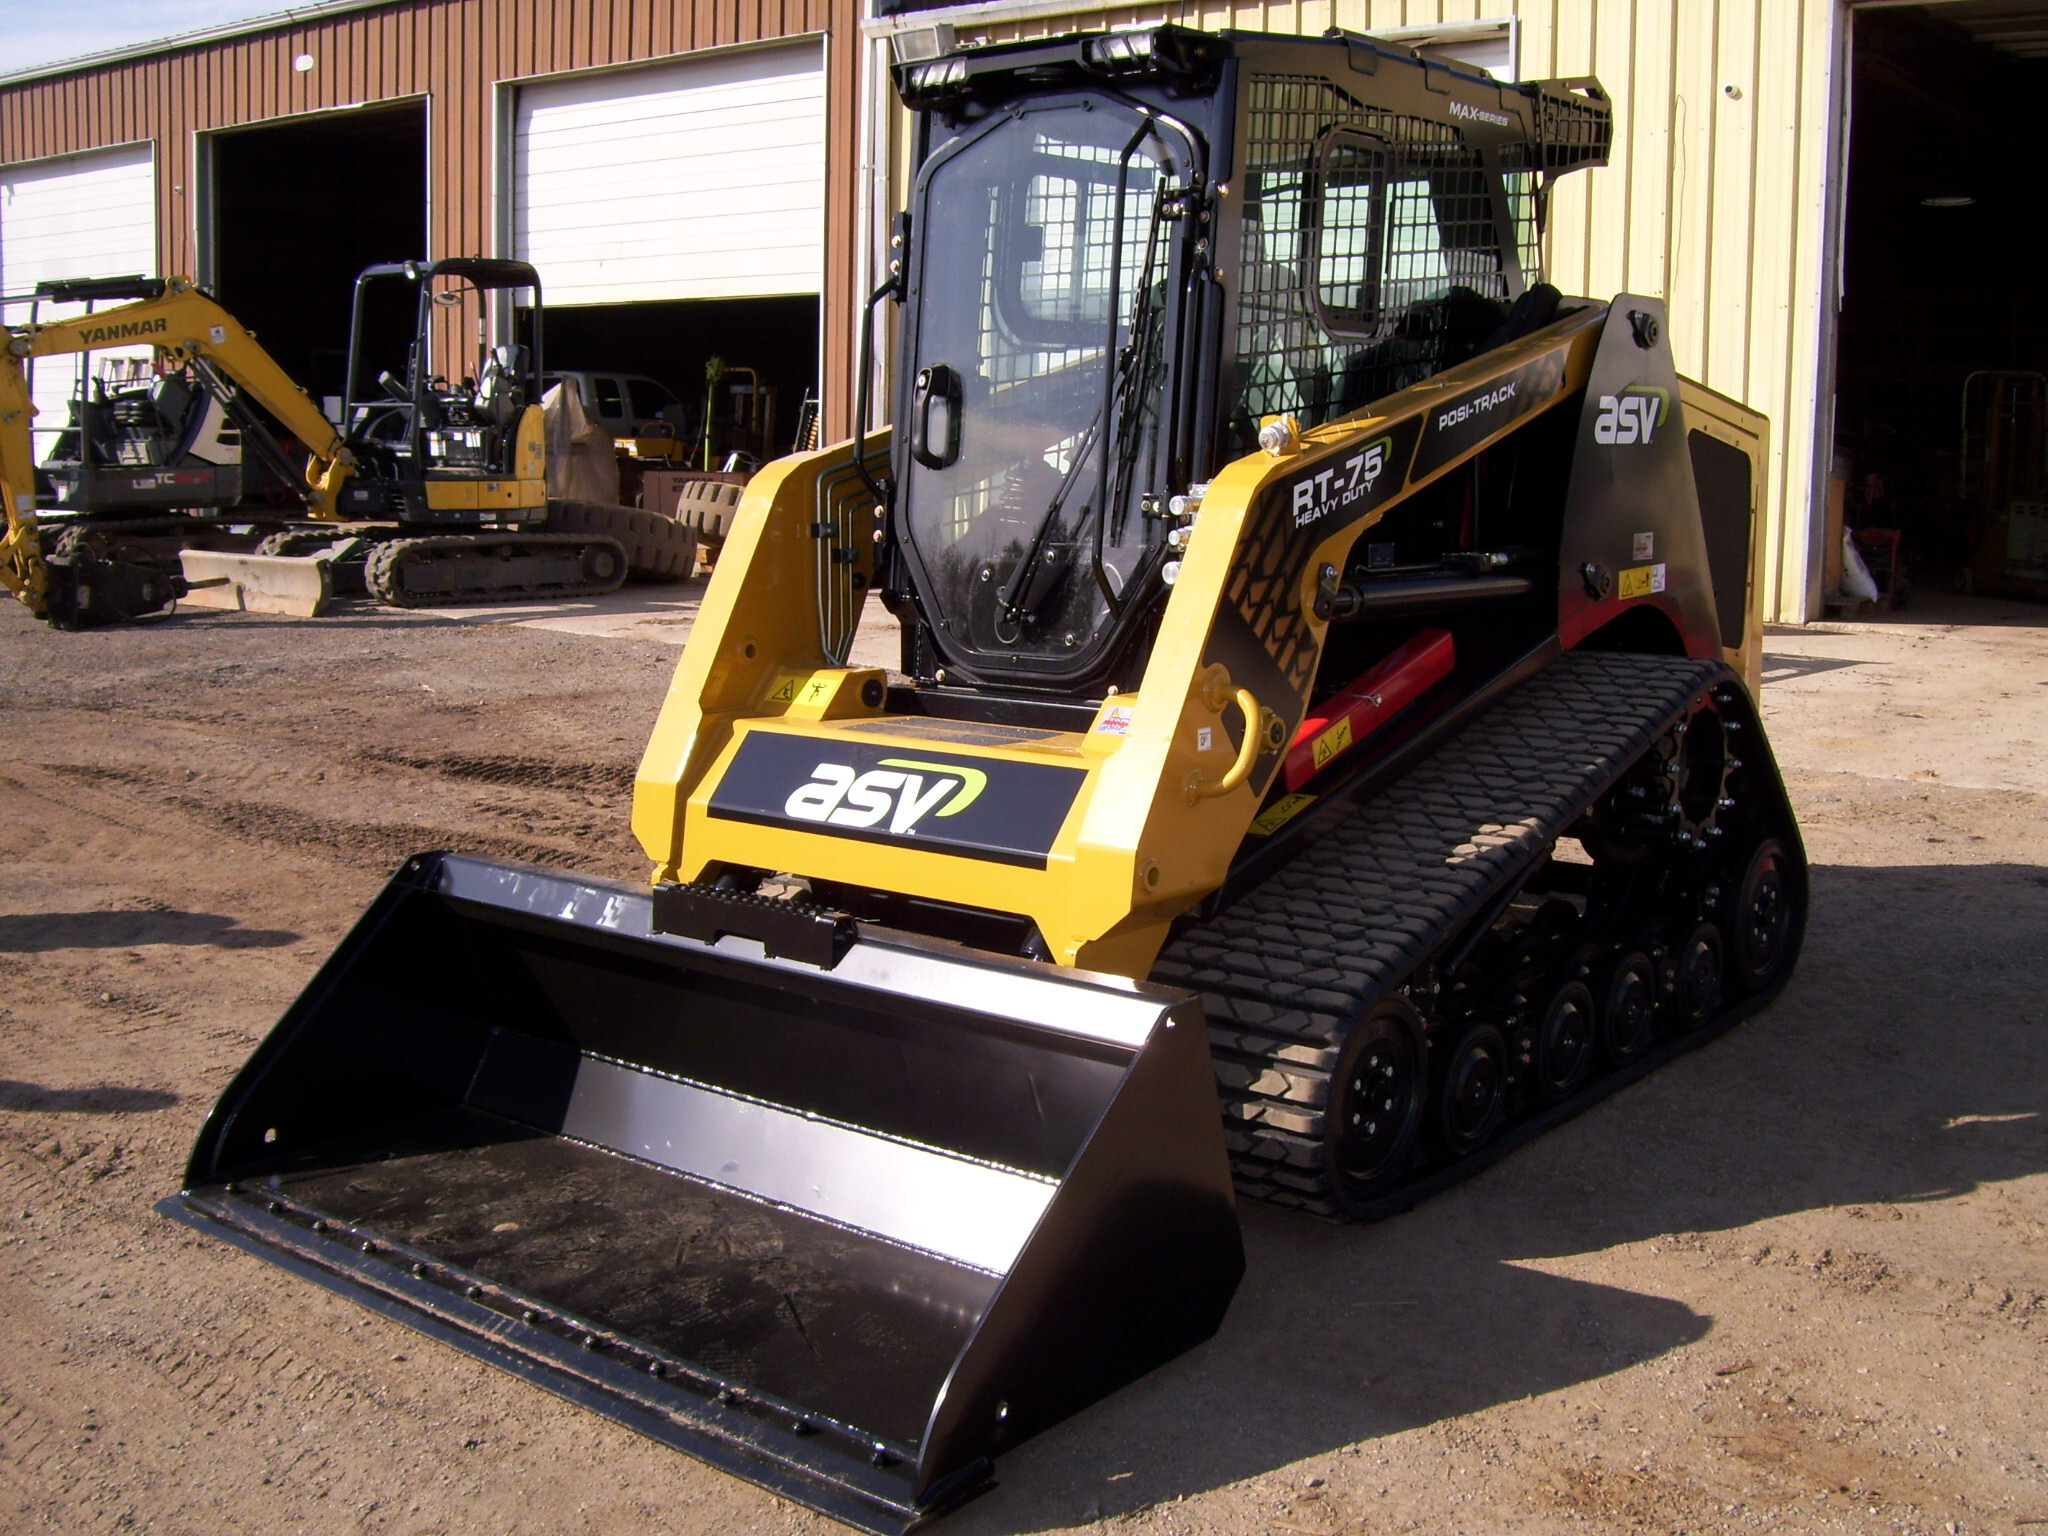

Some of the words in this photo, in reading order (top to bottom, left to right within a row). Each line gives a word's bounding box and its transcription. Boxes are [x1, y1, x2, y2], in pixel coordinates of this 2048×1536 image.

[1449, 101, 1509, 127] MAX-SERIES
[79, 318, 167, 344] YANMAR
[1438, 382, 1516, 431] POSI-TRACK
[1292, 444, 1382, 517] RT-75
[1295, 496, 1339, 529] HEAVY
[1342, 479, 1374, 506] DUTY
